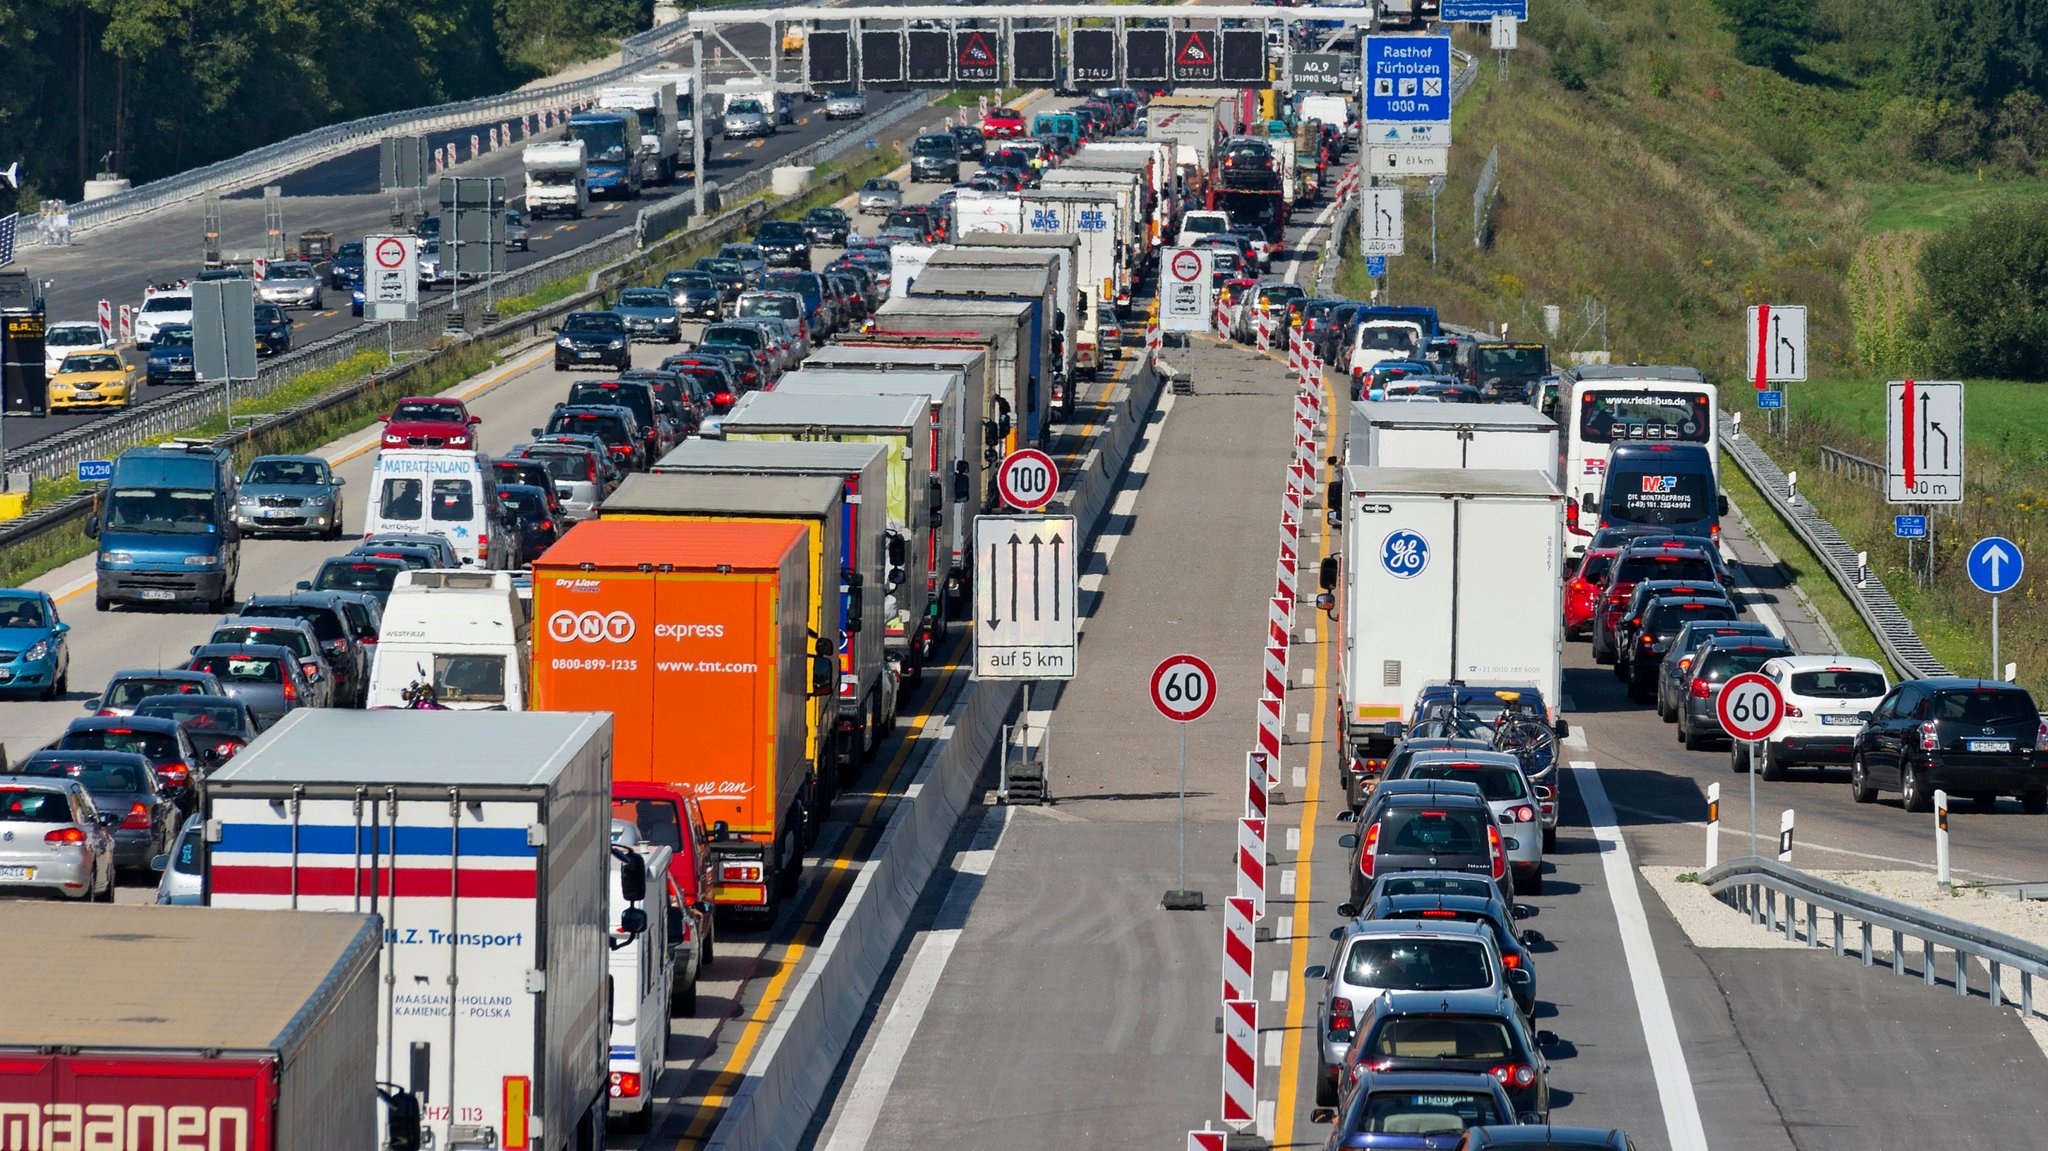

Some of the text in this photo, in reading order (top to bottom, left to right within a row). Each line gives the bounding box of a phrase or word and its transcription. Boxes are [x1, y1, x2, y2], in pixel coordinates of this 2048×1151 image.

[1384, 46, 1432, 58] Rasthof
[962, 68, 992, 77] STAU
[1078, 68, 1108, 77] STAU
[1179, 68, 1210, 77] STAU
[1376, 62, 1440, 74] Fürholzen
[1387, 100, 1429, 112] 1000 m
[1418, 156, 1433, 165] km
[1034, 210, 1056, 219] BLUE
[1081, 211, 1103, 220] BLUE
[1030, 219, 1060, 229] WATER
[1605, 396, 1686, 406] www.riedl-bus.de
[384, 460, 470, 474] MATRATZENLAND
[1011, 466, 1046, 492] 100
[1642, 475, 1677, 493] M&F
[1933, 484, 1947, 494] m
[556, 578, 600, 587] Dry Liner
[553, 615, 631, 639] TNT
[654, 623, 724, 642] express
[990, 651, 1063, 666] auf 5 km
[551, 659, 637, 671] 0800-899-1235
[657, 660, 757, 673] www.tnt.com
[1165, 672, 1201, 701] 60
[1733, 692, 1769, 722] 60
[694, 781, 715, 794] we
[718, 781, 756, 793] can
[429, 930, 523, 948] Transport
[395, 994, 512, 1005] MAASLAN-HOLLAND
[470, 1008, 511, 1017] POLSKA
[428, 1106, 483, 1121] HZ 113
